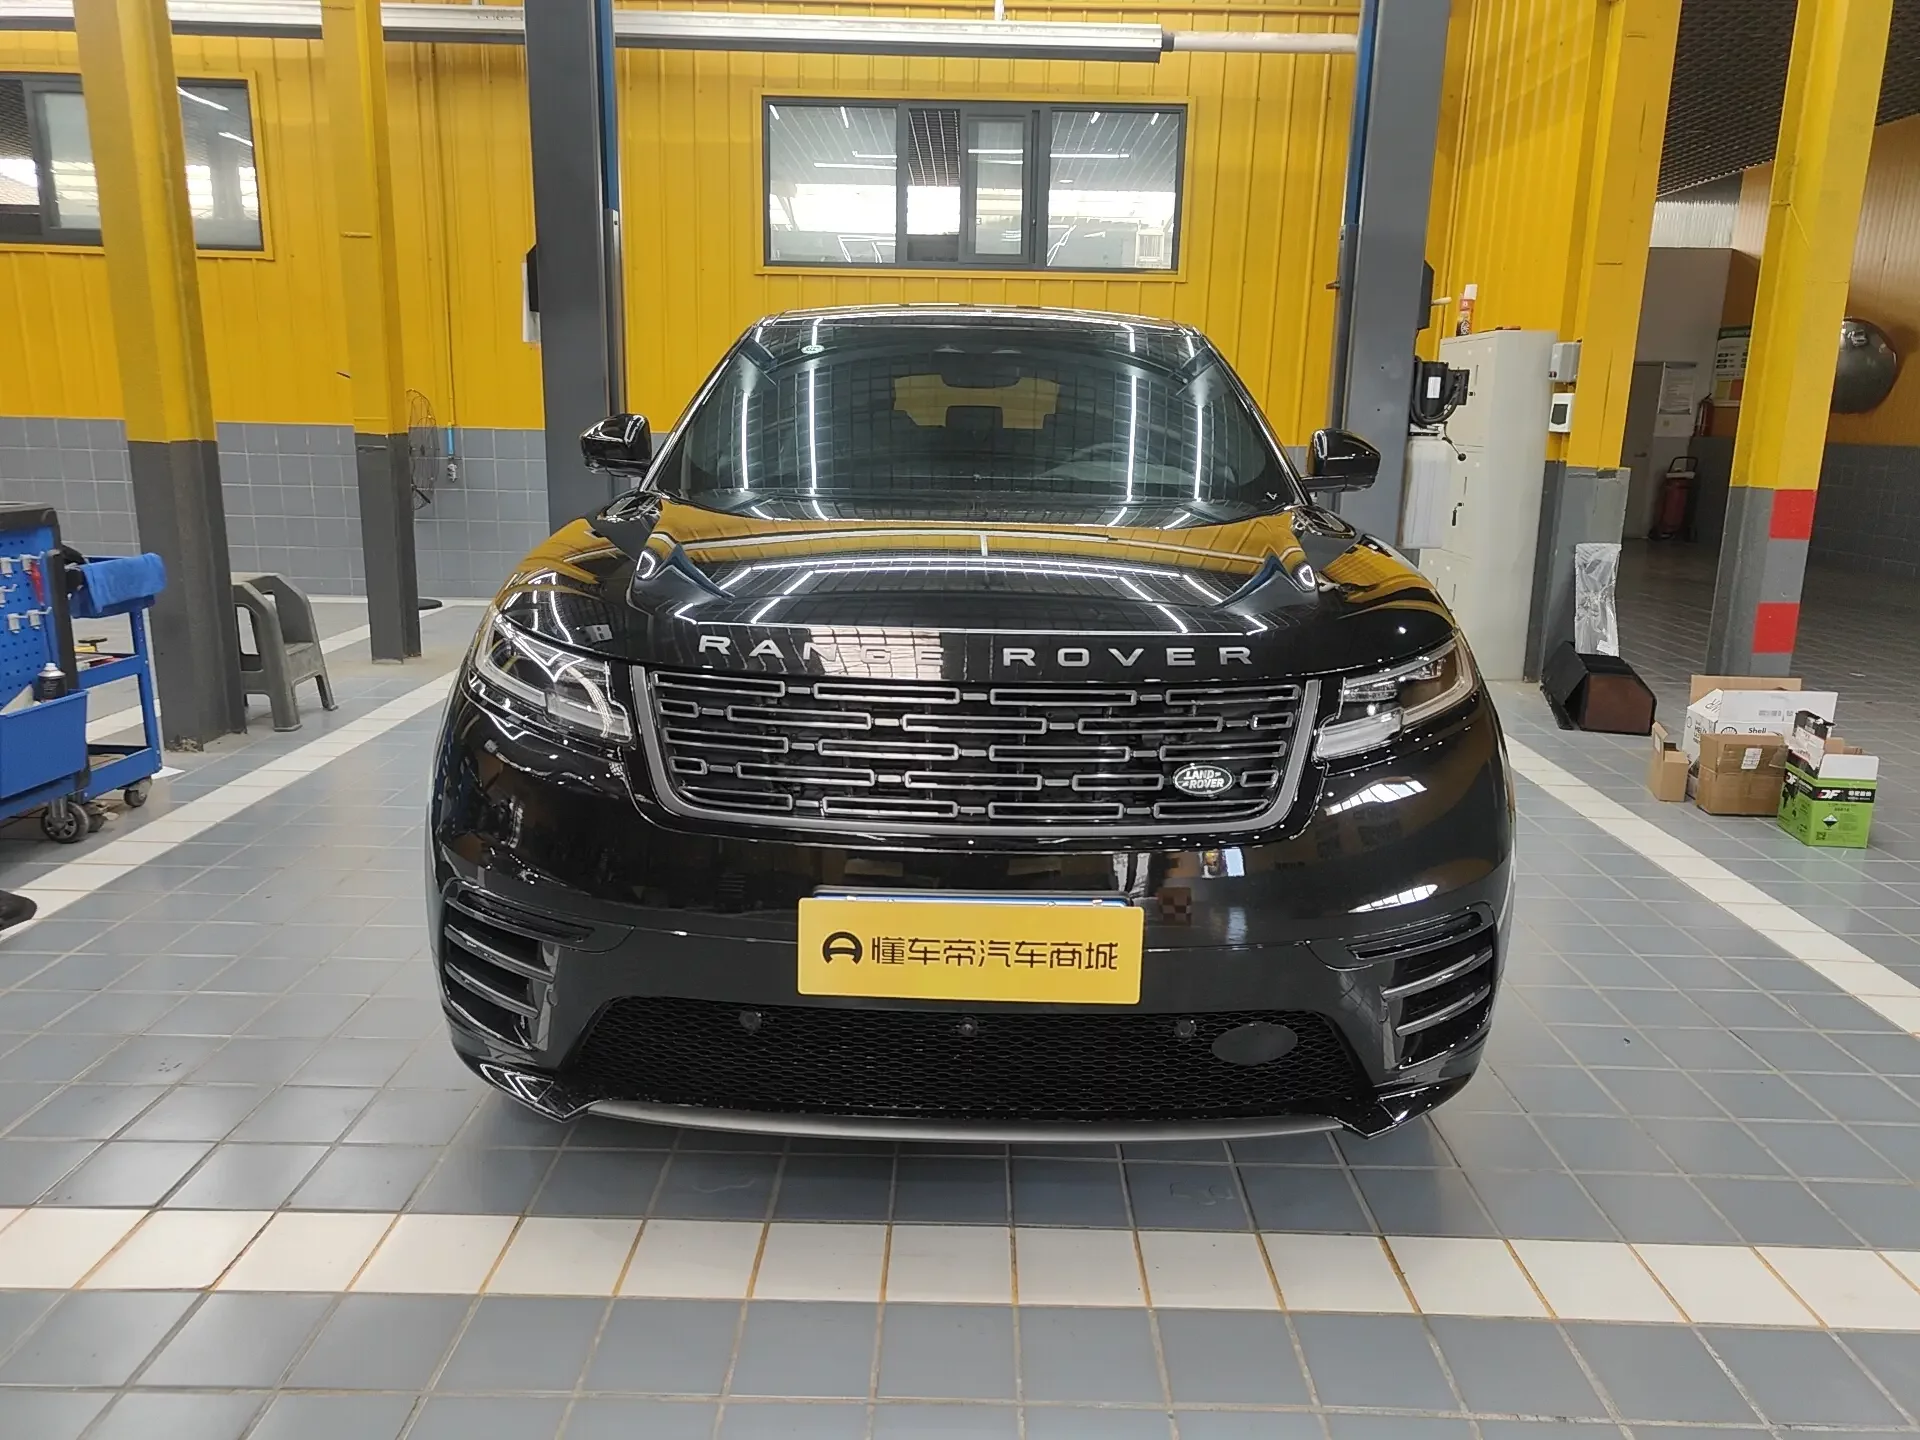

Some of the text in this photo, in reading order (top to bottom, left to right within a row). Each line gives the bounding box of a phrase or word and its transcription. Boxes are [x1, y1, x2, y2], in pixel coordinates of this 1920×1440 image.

[698, 634, 1252, 667] RANGE ROVER
[1748, 726, 1767, 734] Shell
[1183, 769, 1215, 780] LAND
[1188, 777, 1225, 789] ROVER
[871, 936, 1119, 971] 懂车帝汽车商城
